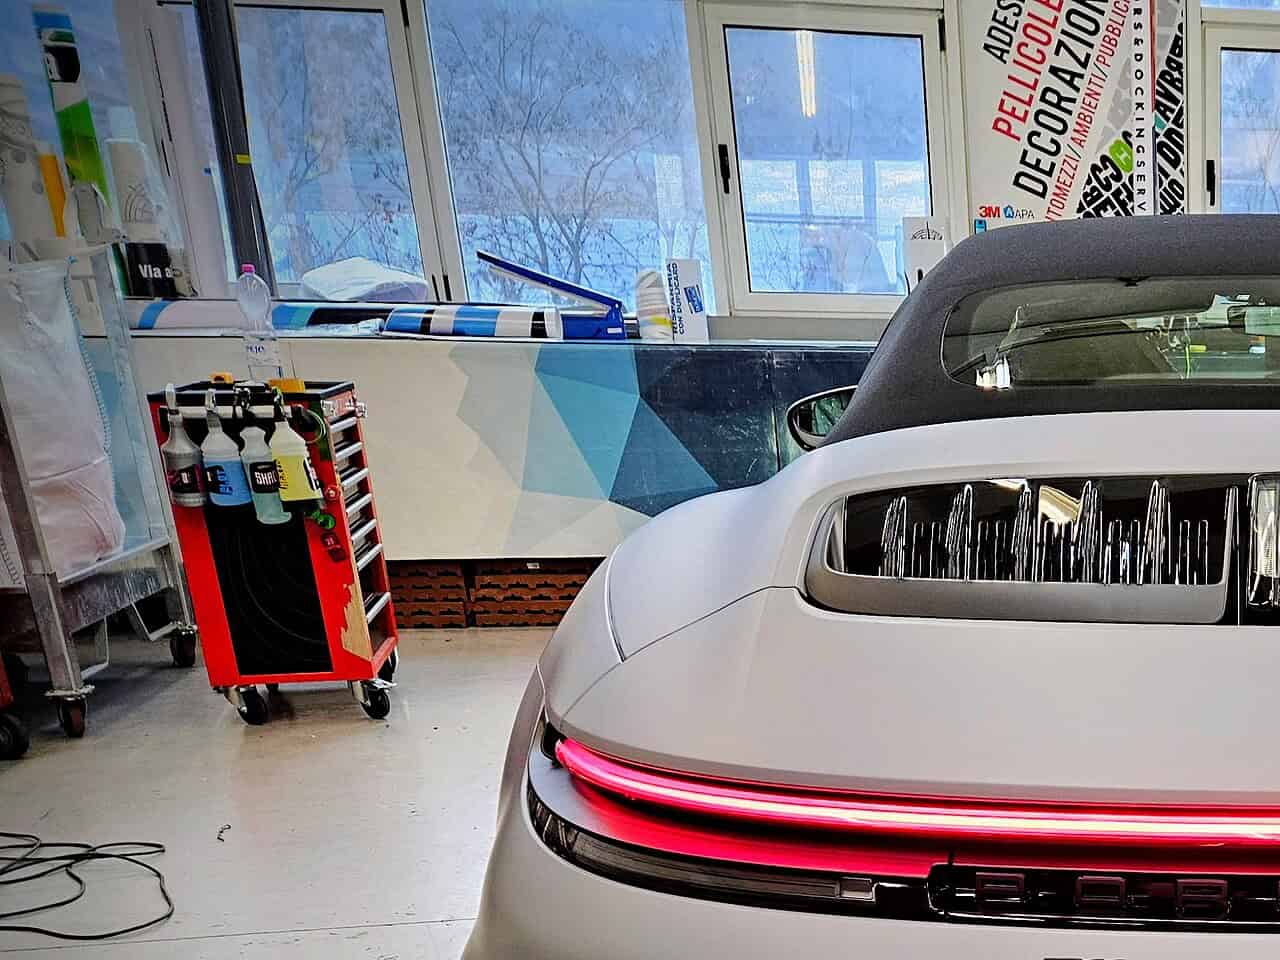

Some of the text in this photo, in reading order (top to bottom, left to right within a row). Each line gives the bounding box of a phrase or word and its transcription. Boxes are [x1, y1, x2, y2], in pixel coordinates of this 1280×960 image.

[983, 0, 1026, 64] ADES
[979, 206, 1001, 218] 3M
[138, 264, 162, 278] Via
